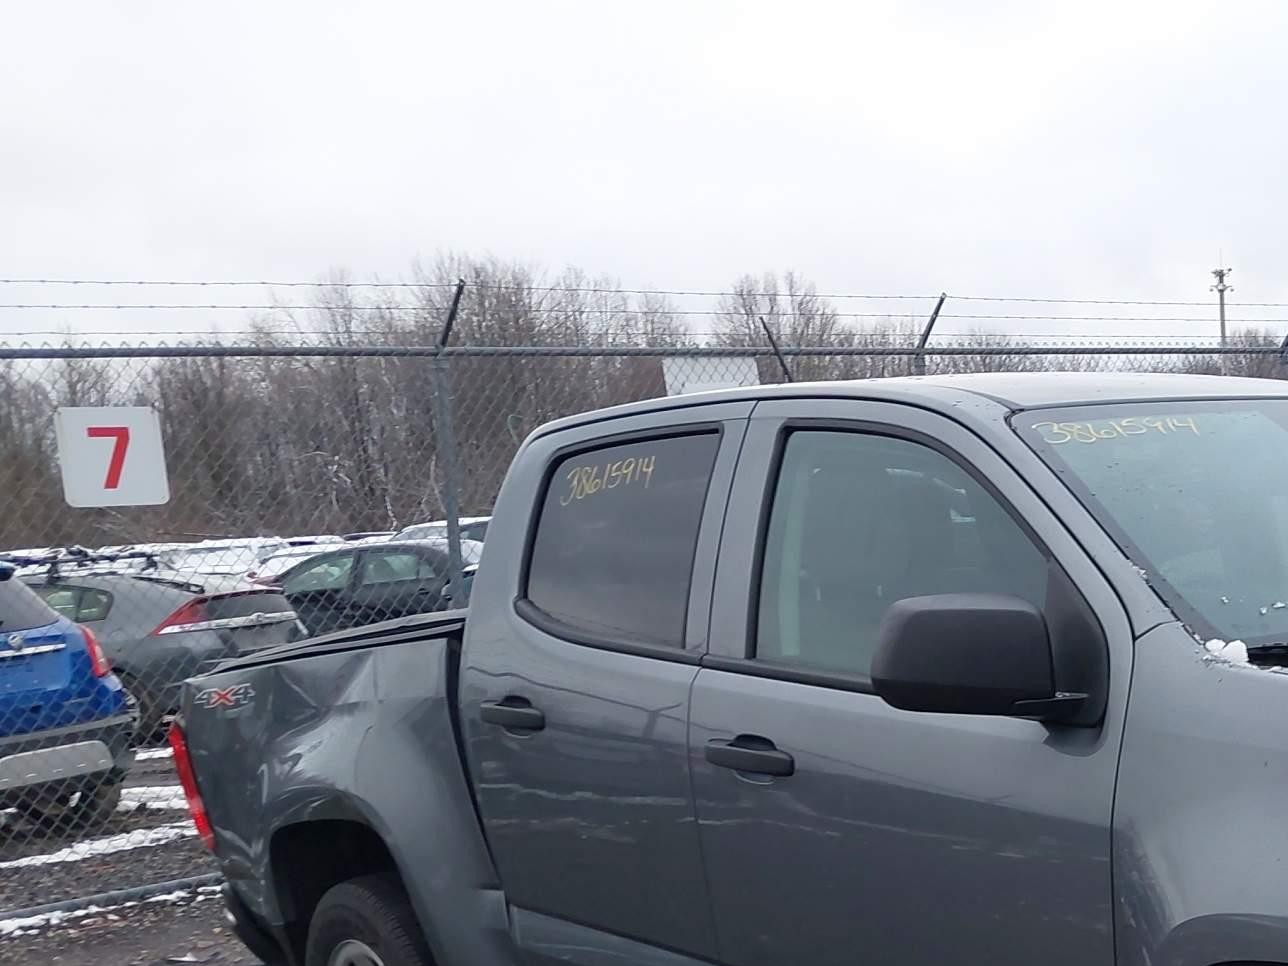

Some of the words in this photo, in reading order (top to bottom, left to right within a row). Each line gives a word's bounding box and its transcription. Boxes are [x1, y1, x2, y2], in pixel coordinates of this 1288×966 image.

[1031, 417, 1200, 444] 38615914
[86, 426, 130, 490] 7
[559, 455, 656, 507] 38615914
